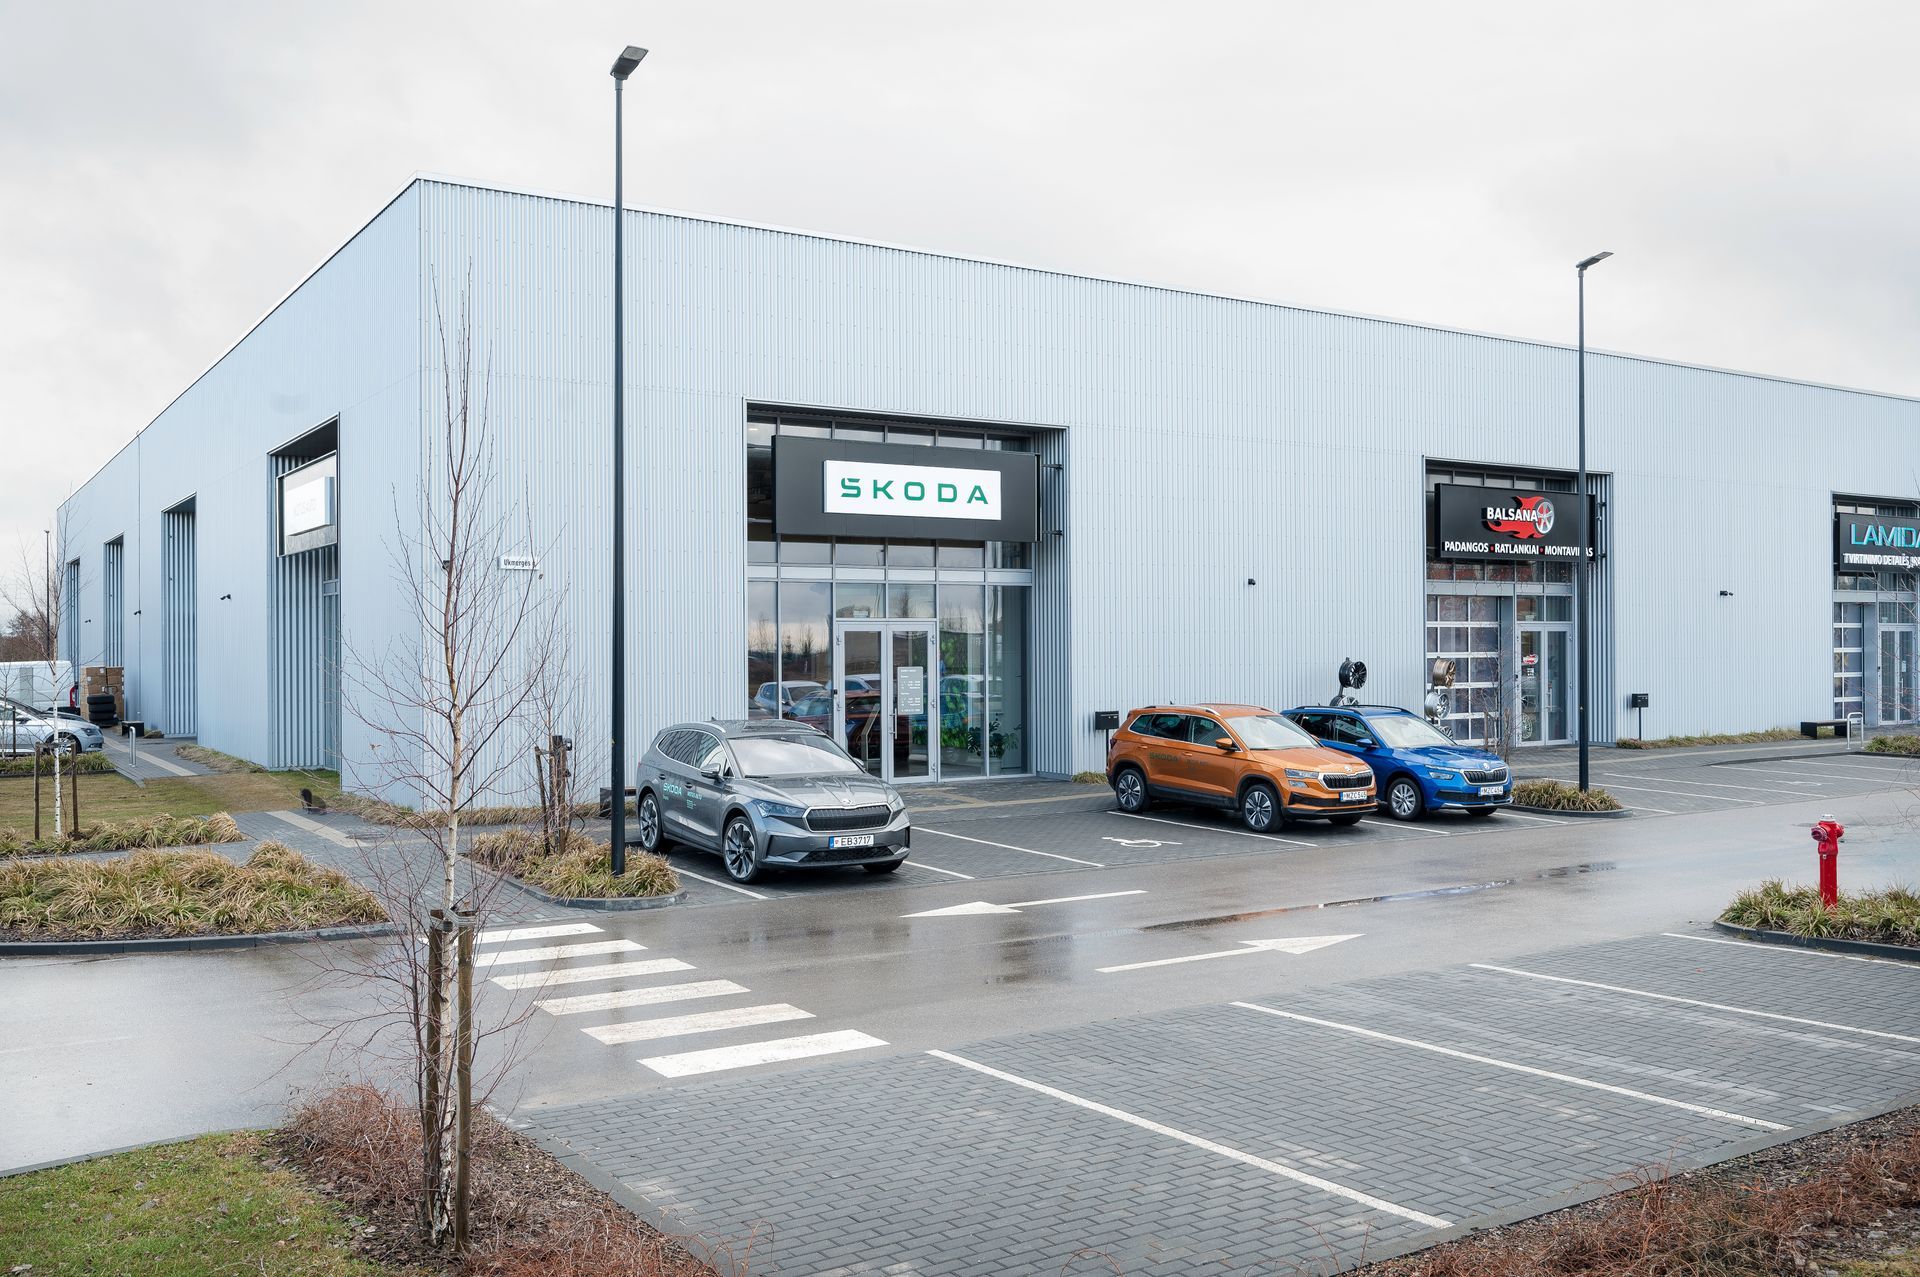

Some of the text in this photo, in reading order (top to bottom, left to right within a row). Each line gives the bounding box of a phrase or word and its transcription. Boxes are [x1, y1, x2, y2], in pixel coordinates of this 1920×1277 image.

[1486, 507, 1538, 522] BALSANA
[1444, 541, 1593, 557] PADANGOS RATLANKIAI MONTAVIAS
[840, 836, 871, 846] EB3717
